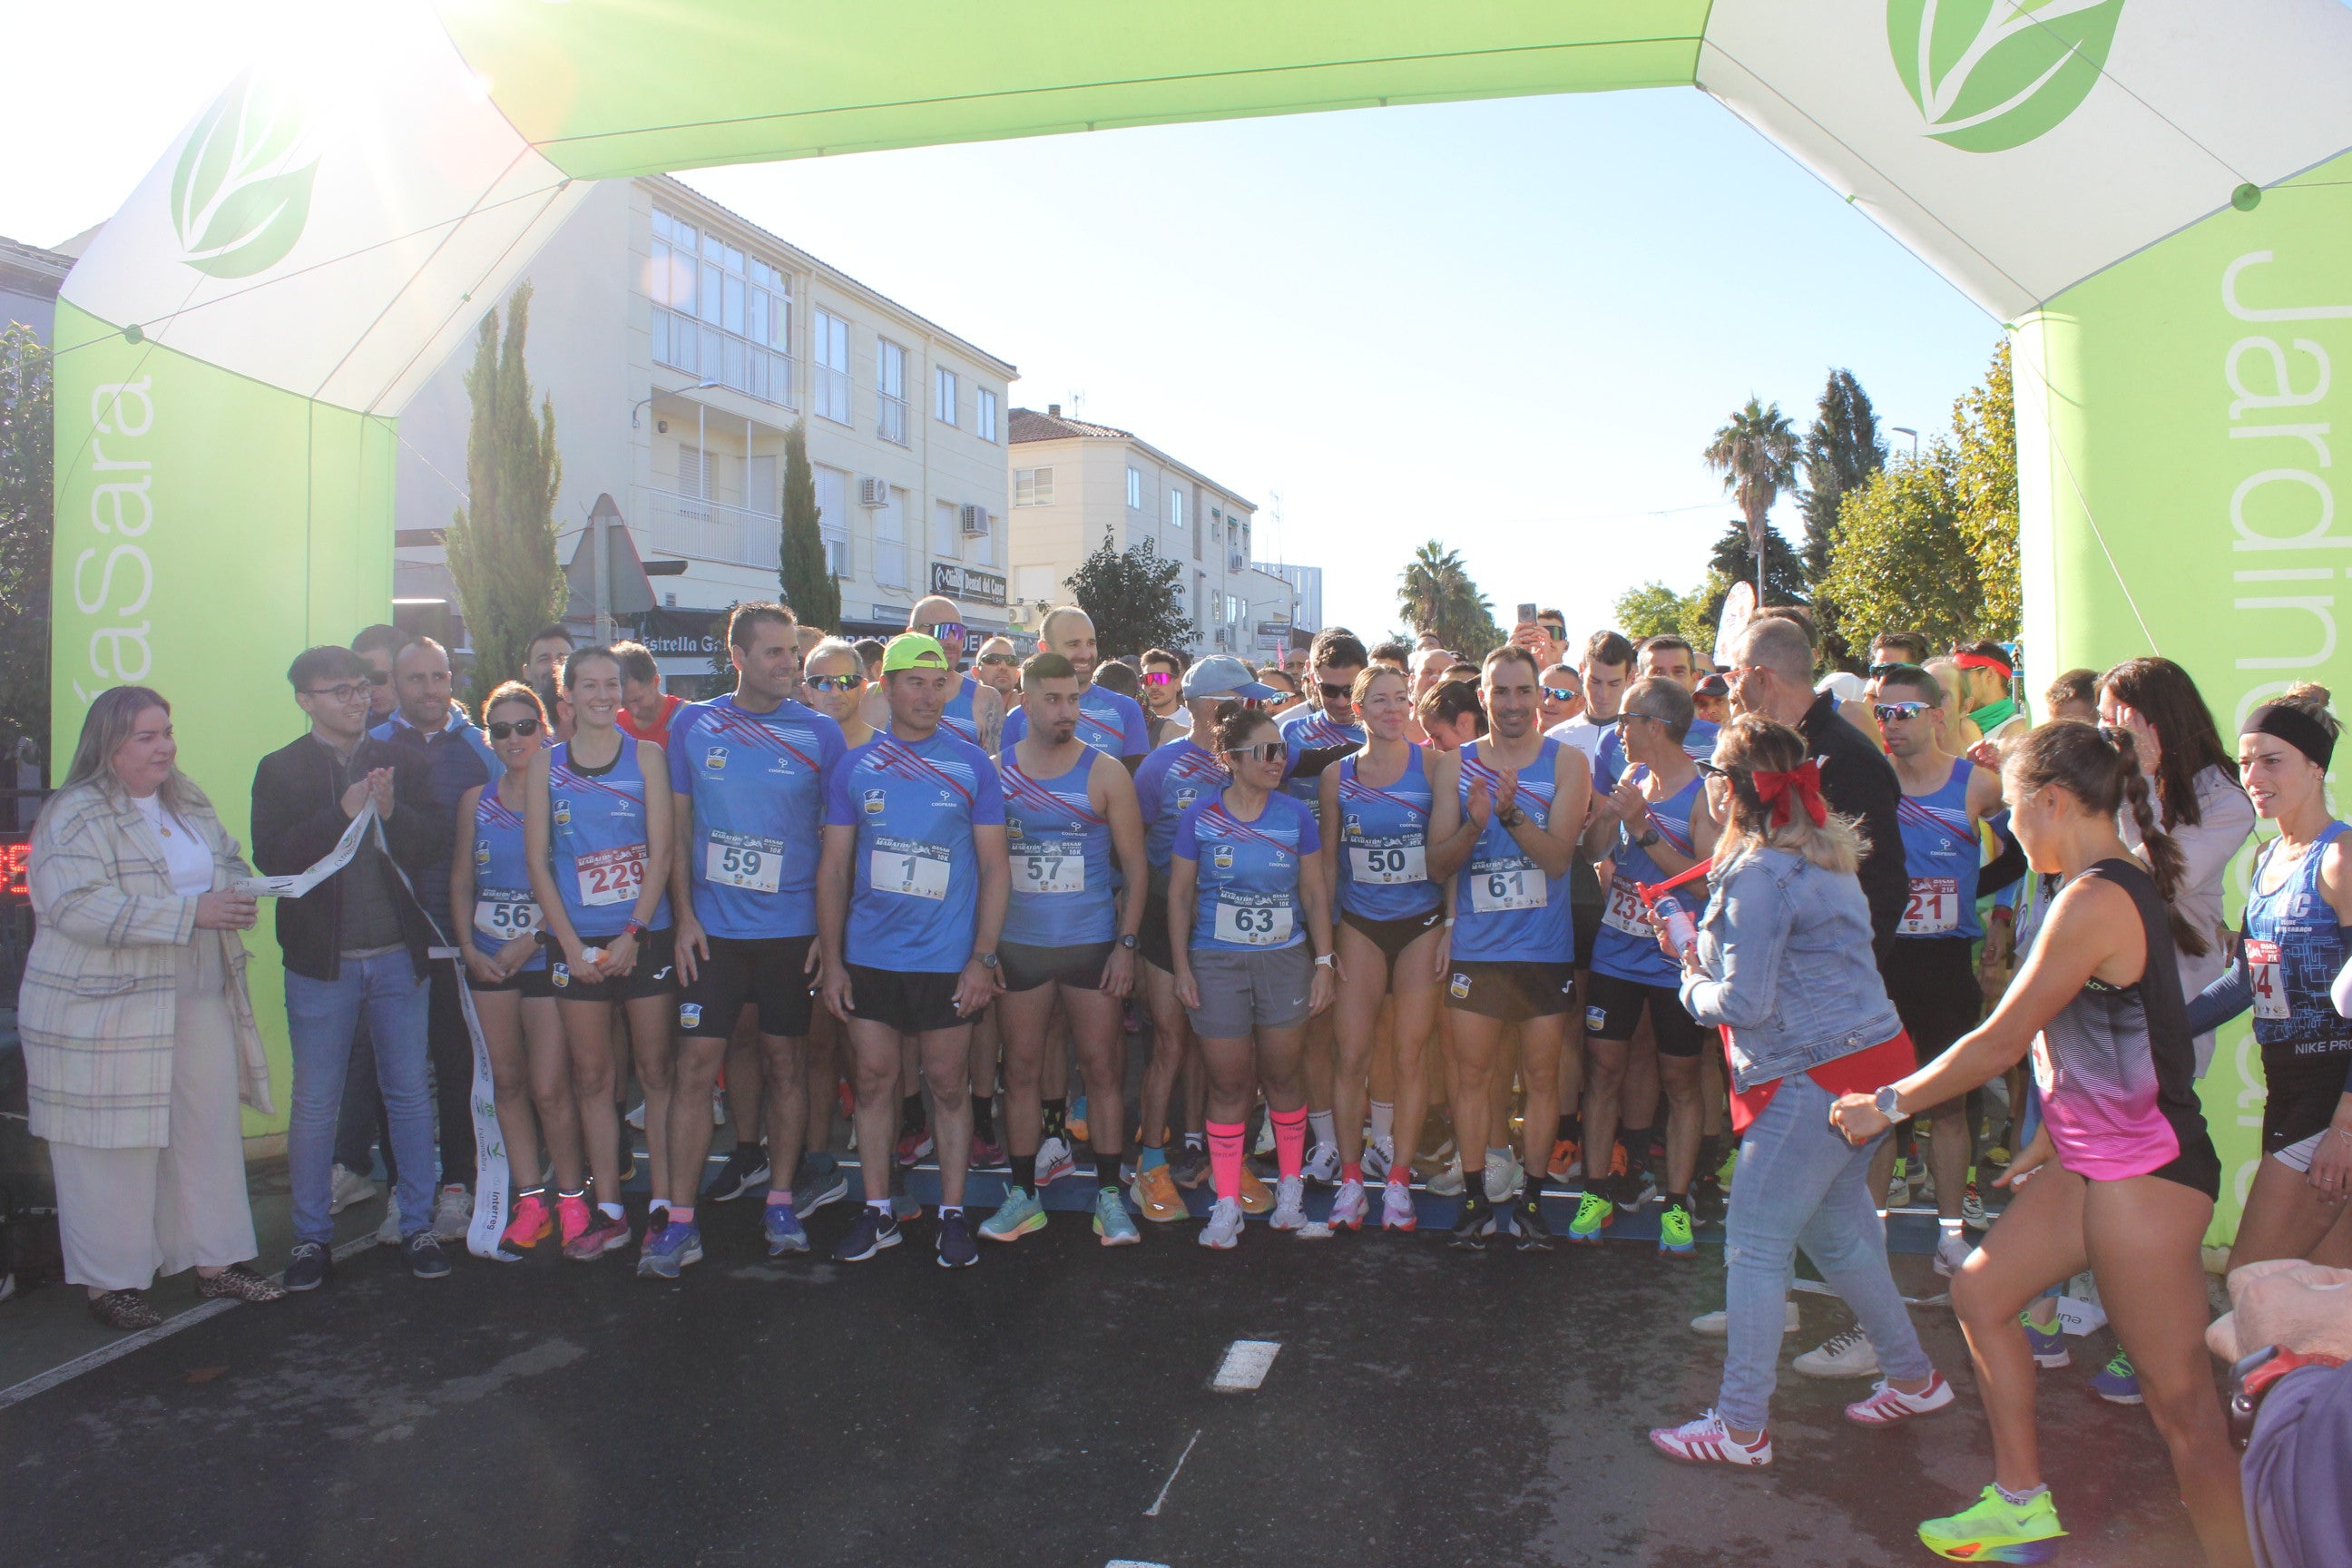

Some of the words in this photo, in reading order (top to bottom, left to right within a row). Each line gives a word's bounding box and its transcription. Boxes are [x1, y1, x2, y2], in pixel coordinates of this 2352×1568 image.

[643, 636, 697, 652] Estrella
[722, 847, 762, 876] 59
[901, 856, 917, 881] 1
[1027, 857, 1063, 880] 57
[1367, 849, 1406, 872] 50
[589, 860, 645, 895] 229
[1488, 871, 1524, 898] 61
[493, 904, 532, 928] 56
[1904, 894, 1942, 920] 21
[1235, 907, 1274, 933] 63
[2295, 1042, 2327, 1054] NIKE
[486, 1191, 501, 1231] Interreg
